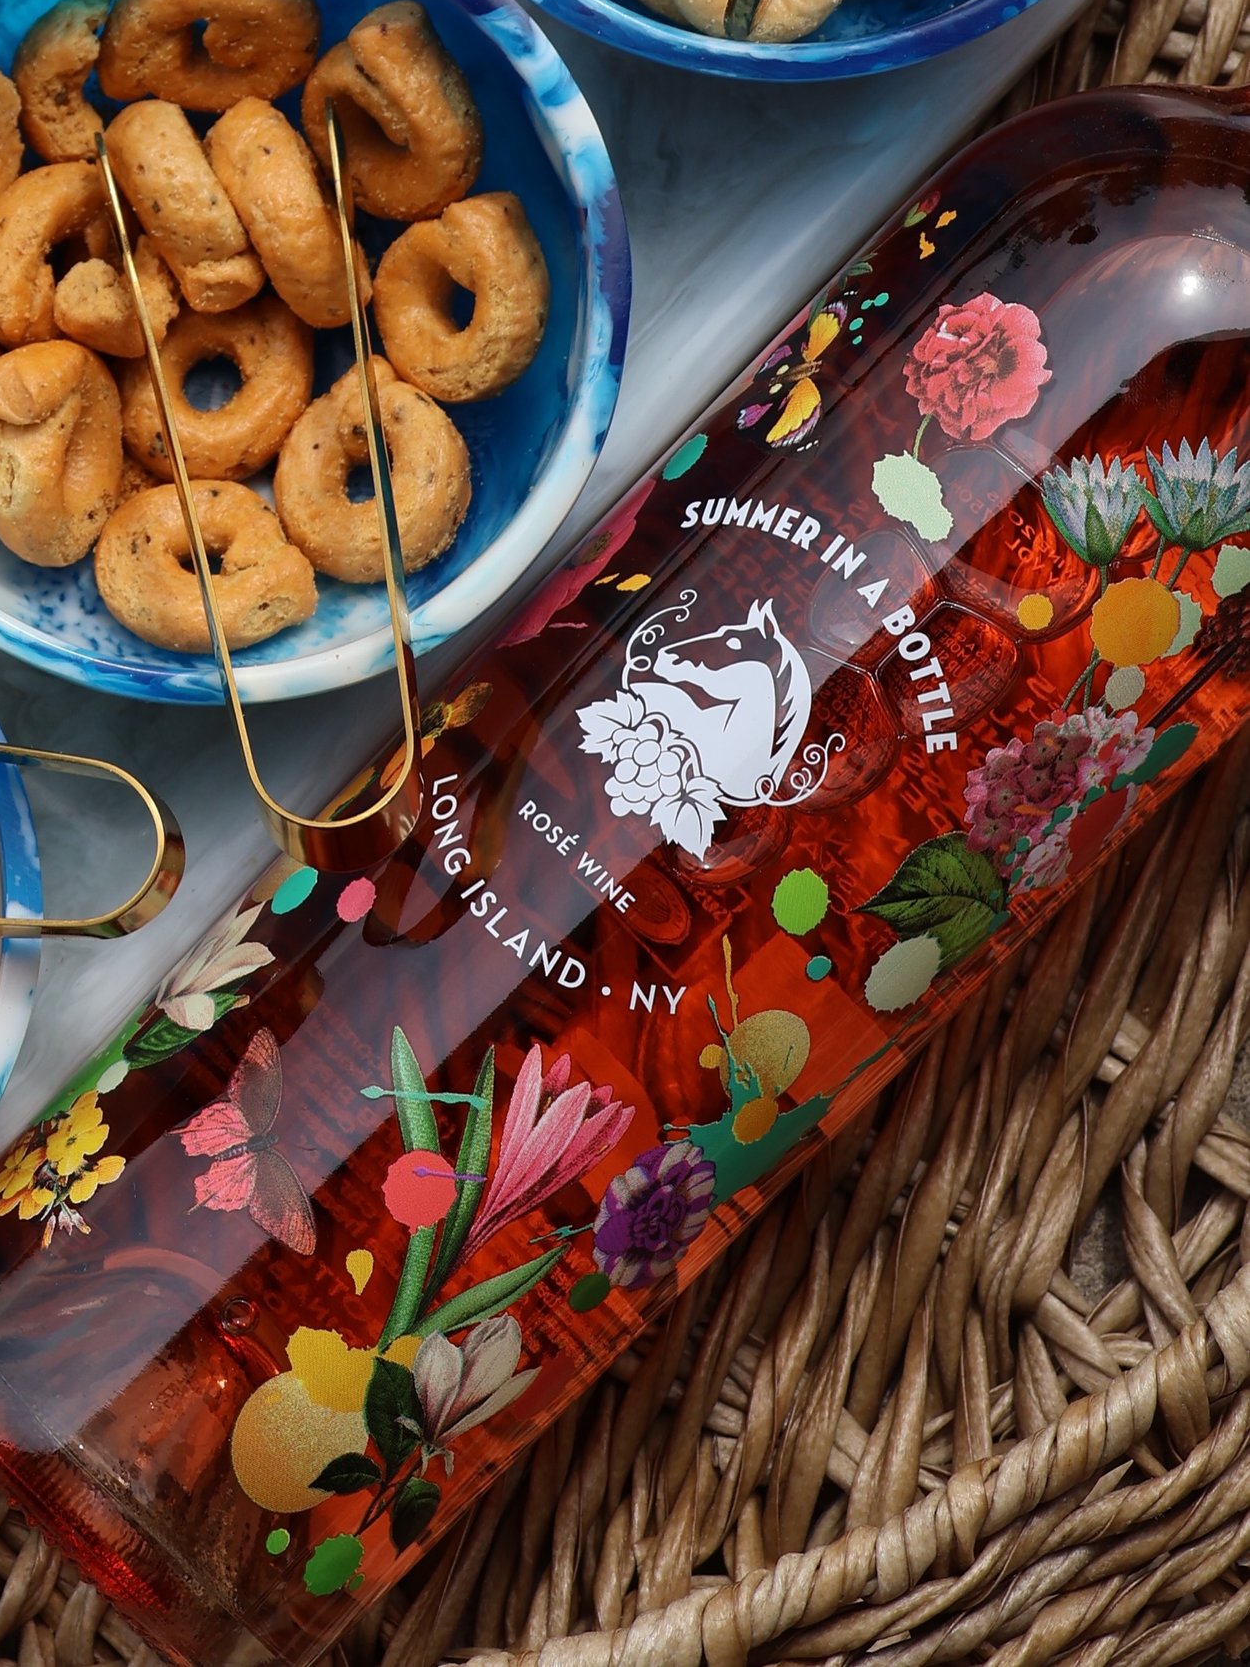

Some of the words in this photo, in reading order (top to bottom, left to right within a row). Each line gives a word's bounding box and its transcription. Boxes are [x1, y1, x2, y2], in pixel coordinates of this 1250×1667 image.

[680, 497, 823, 552] SUMMER
[819, 534, 869, 582] IN
[857, 575, 890, 610] A
[881, 604, 959, 754] BOTTLE
[431, 773, 471, 876] LONG
[460, 879, 588, 990] ISLAND
[628, 980, 688, 1016] NY
[518, 799, 581, 859] ROSÉ
[577, 851, 636, 914] WINE
